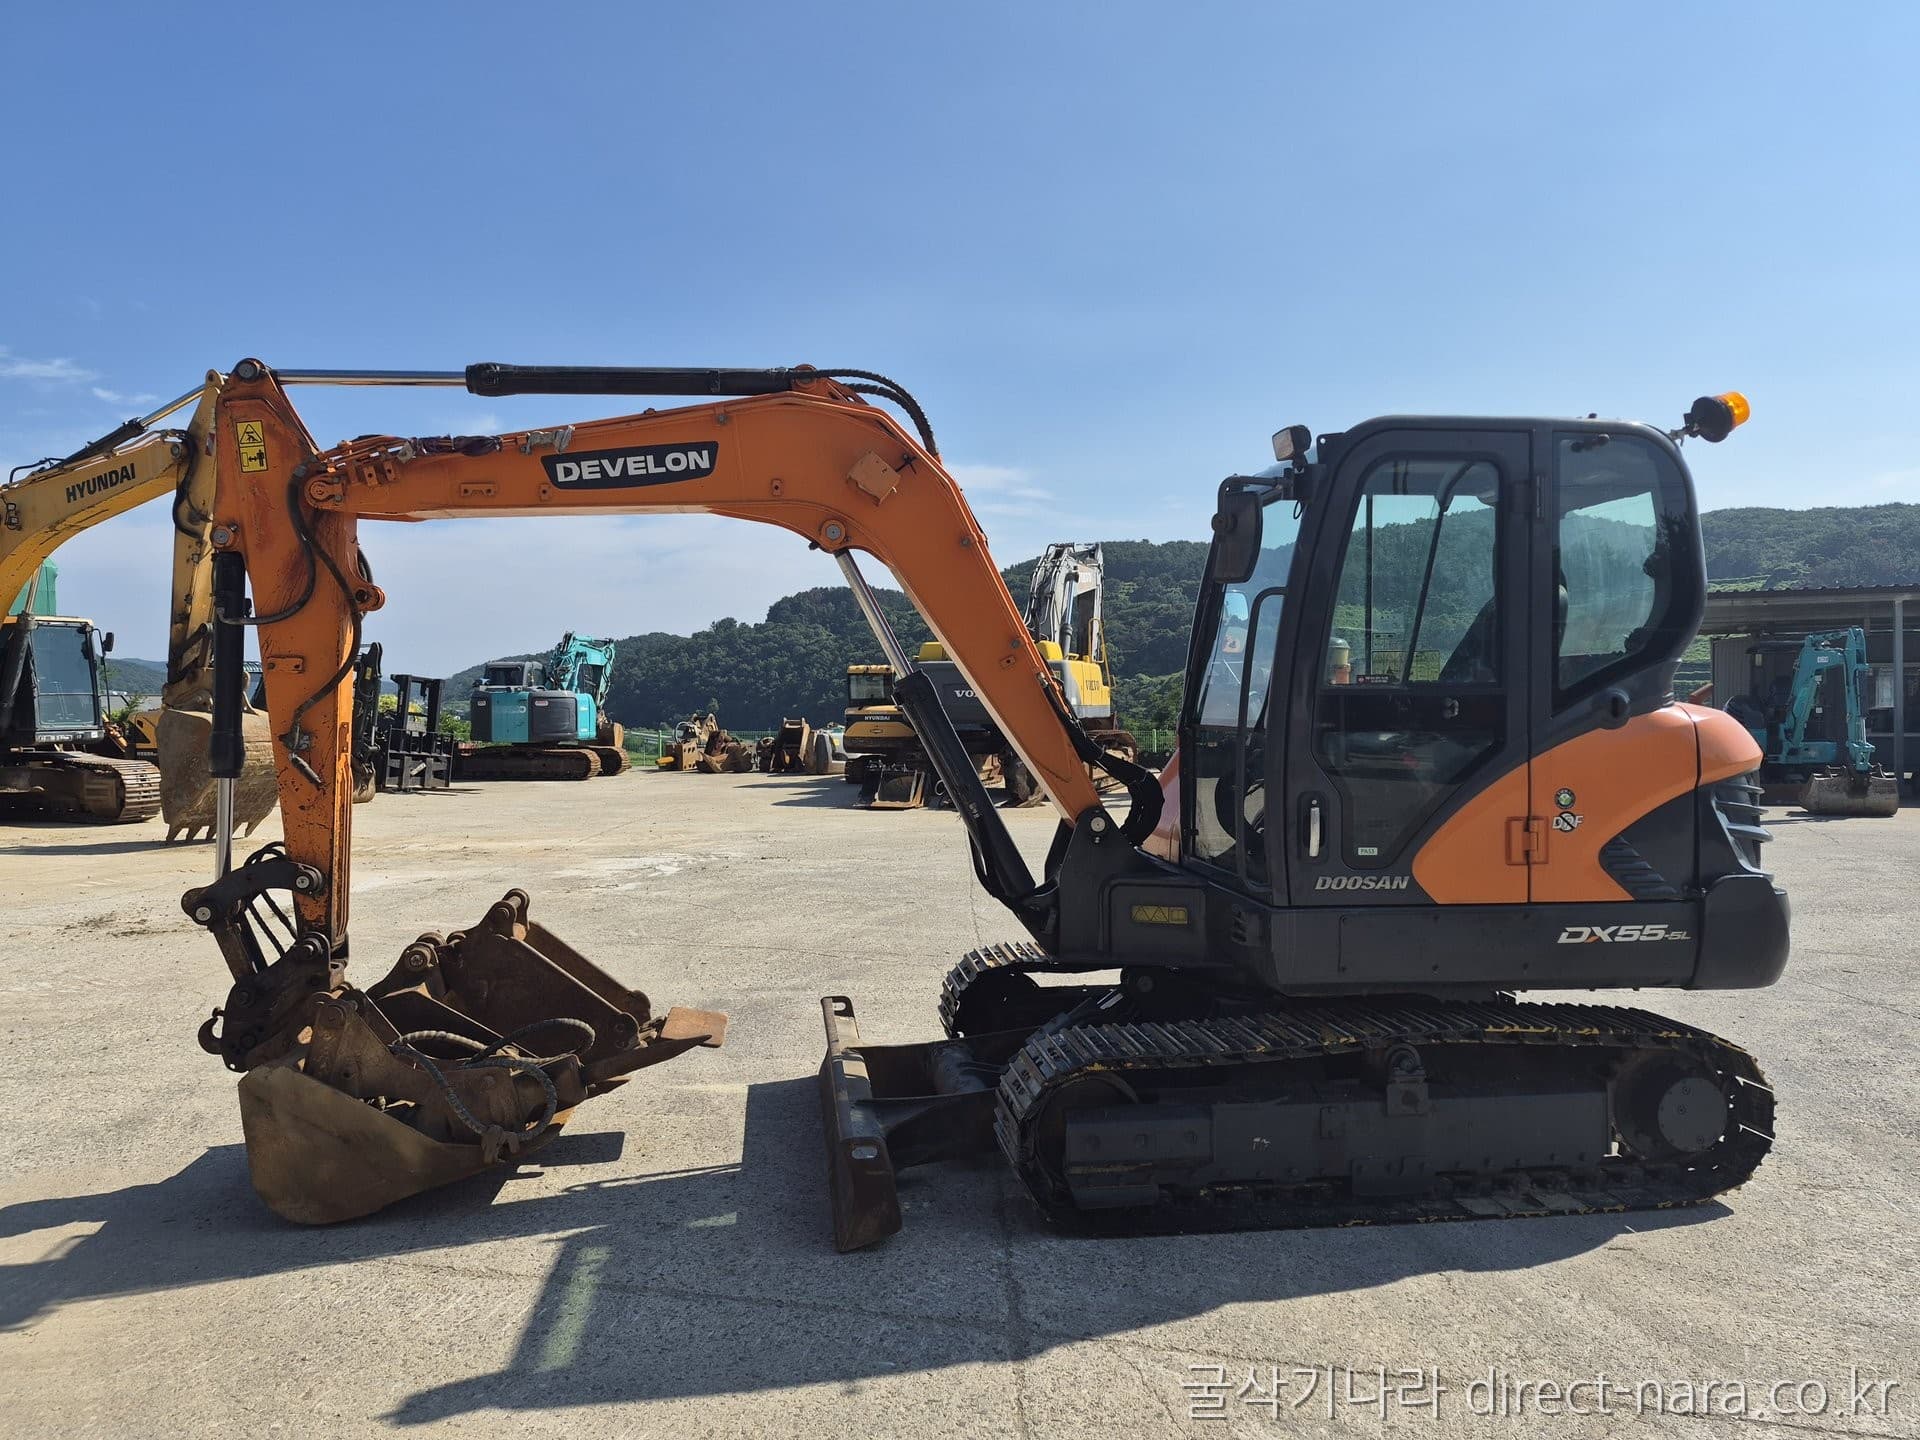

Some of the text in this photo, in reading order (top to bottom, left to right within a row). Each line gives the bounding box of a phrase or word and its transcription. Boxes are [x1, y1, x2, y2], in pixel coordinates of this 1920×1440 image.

[65, 462, 136, 504] HYUNDAI
[555, 450, 711, 483] DEVELON
[1314, 875, 1410, 890] DOOSAN
